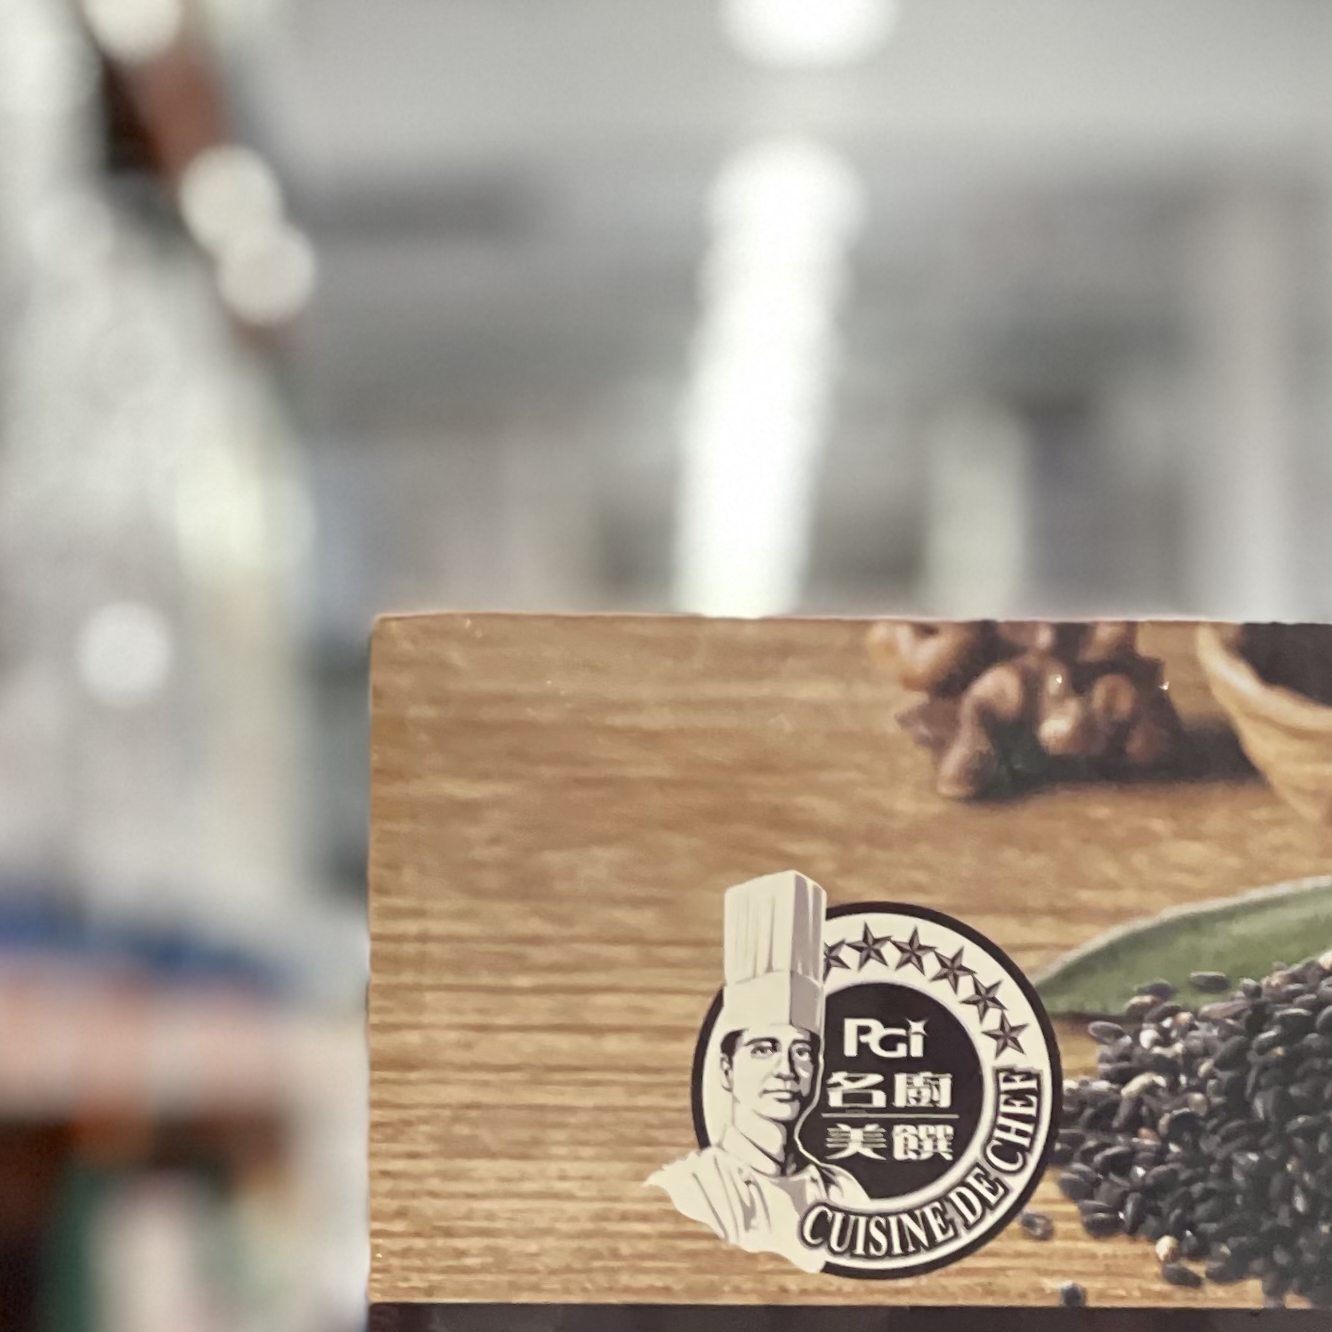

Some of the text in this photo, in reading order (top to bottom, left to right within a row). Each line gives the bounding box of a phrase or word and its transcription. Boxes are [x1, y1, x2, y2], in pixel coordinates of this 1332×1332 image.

[803, 1071, 1039, 1256] CUISINE DE CHEF
